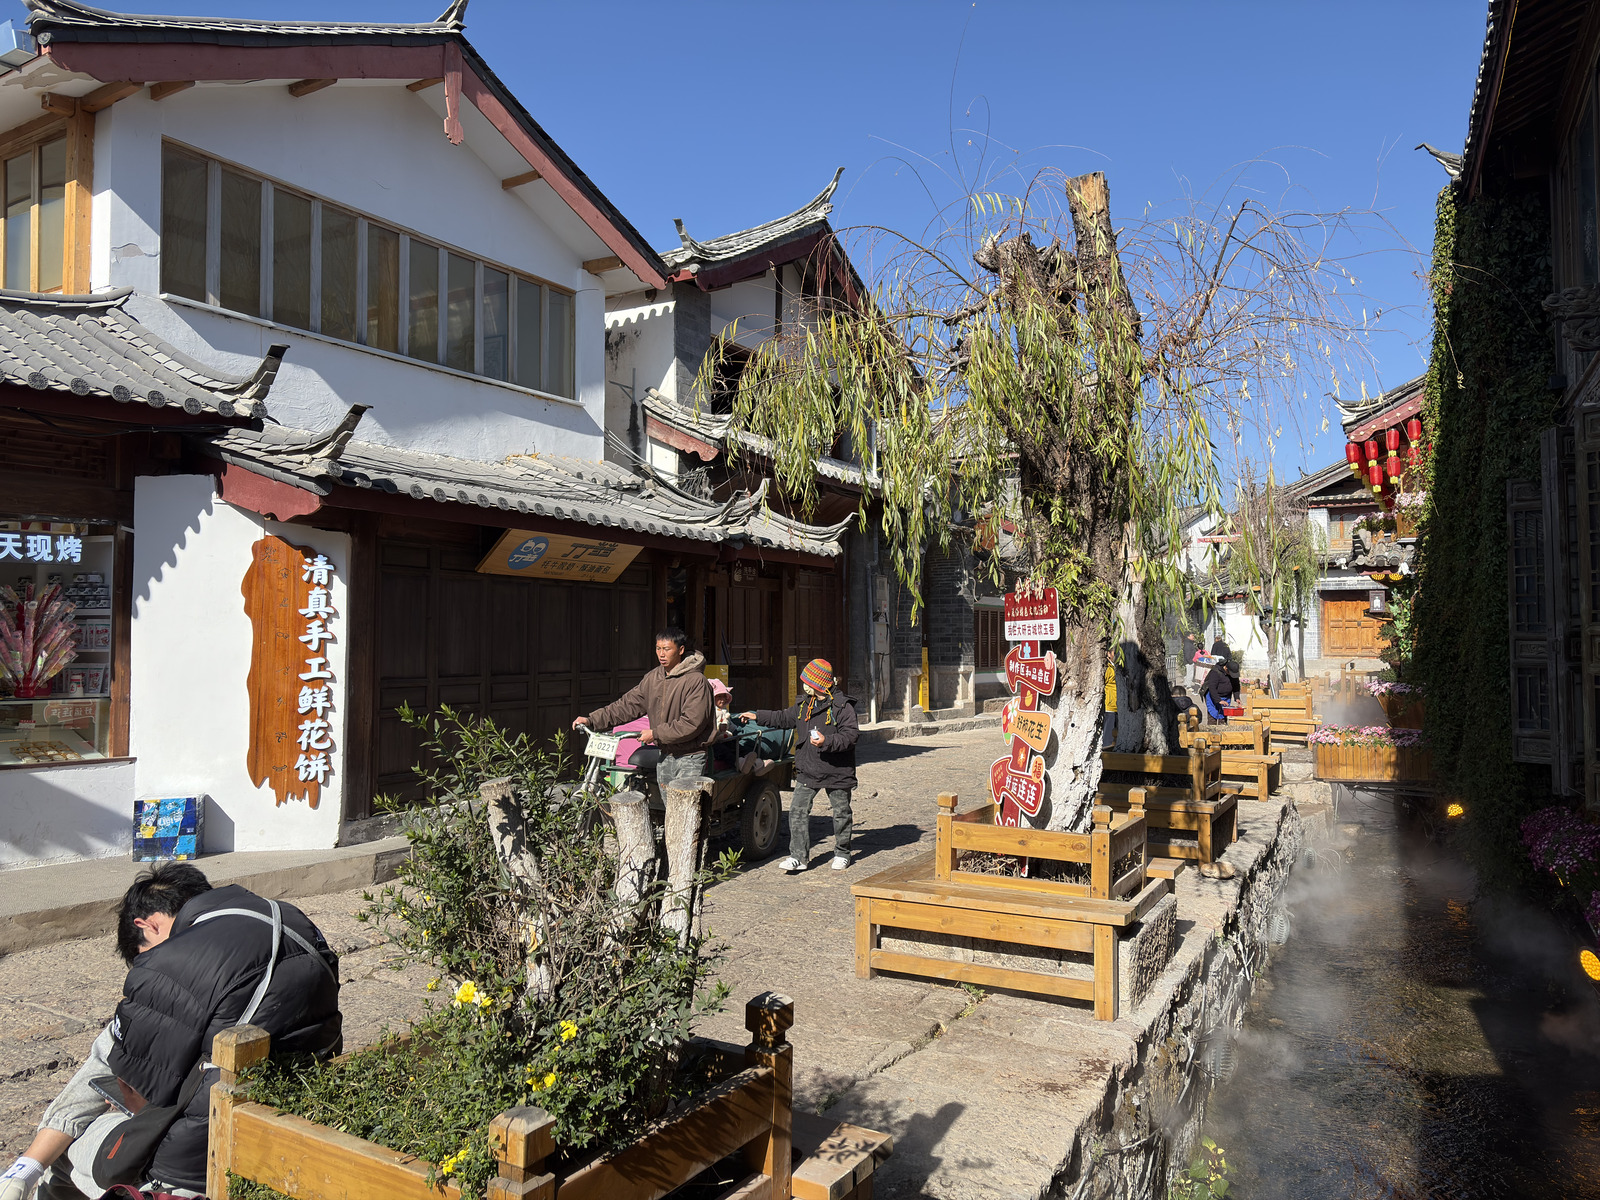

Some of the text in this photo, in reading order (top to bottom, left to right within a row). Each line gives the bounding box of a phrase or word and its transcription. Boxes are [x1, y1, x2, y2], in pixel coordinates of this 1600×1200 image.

[0, 533, 83, 563] 天现烤
[294, 554, 335, 784] 清真手工鲜花饼
[1009, 660, 1050, 684] 制作区和品尝区
[1017, 715, 1044, 740] 好柿花生
[1033, 761, 1043, 778] 福
[1005, 775, 1038, 807] 好运连连
